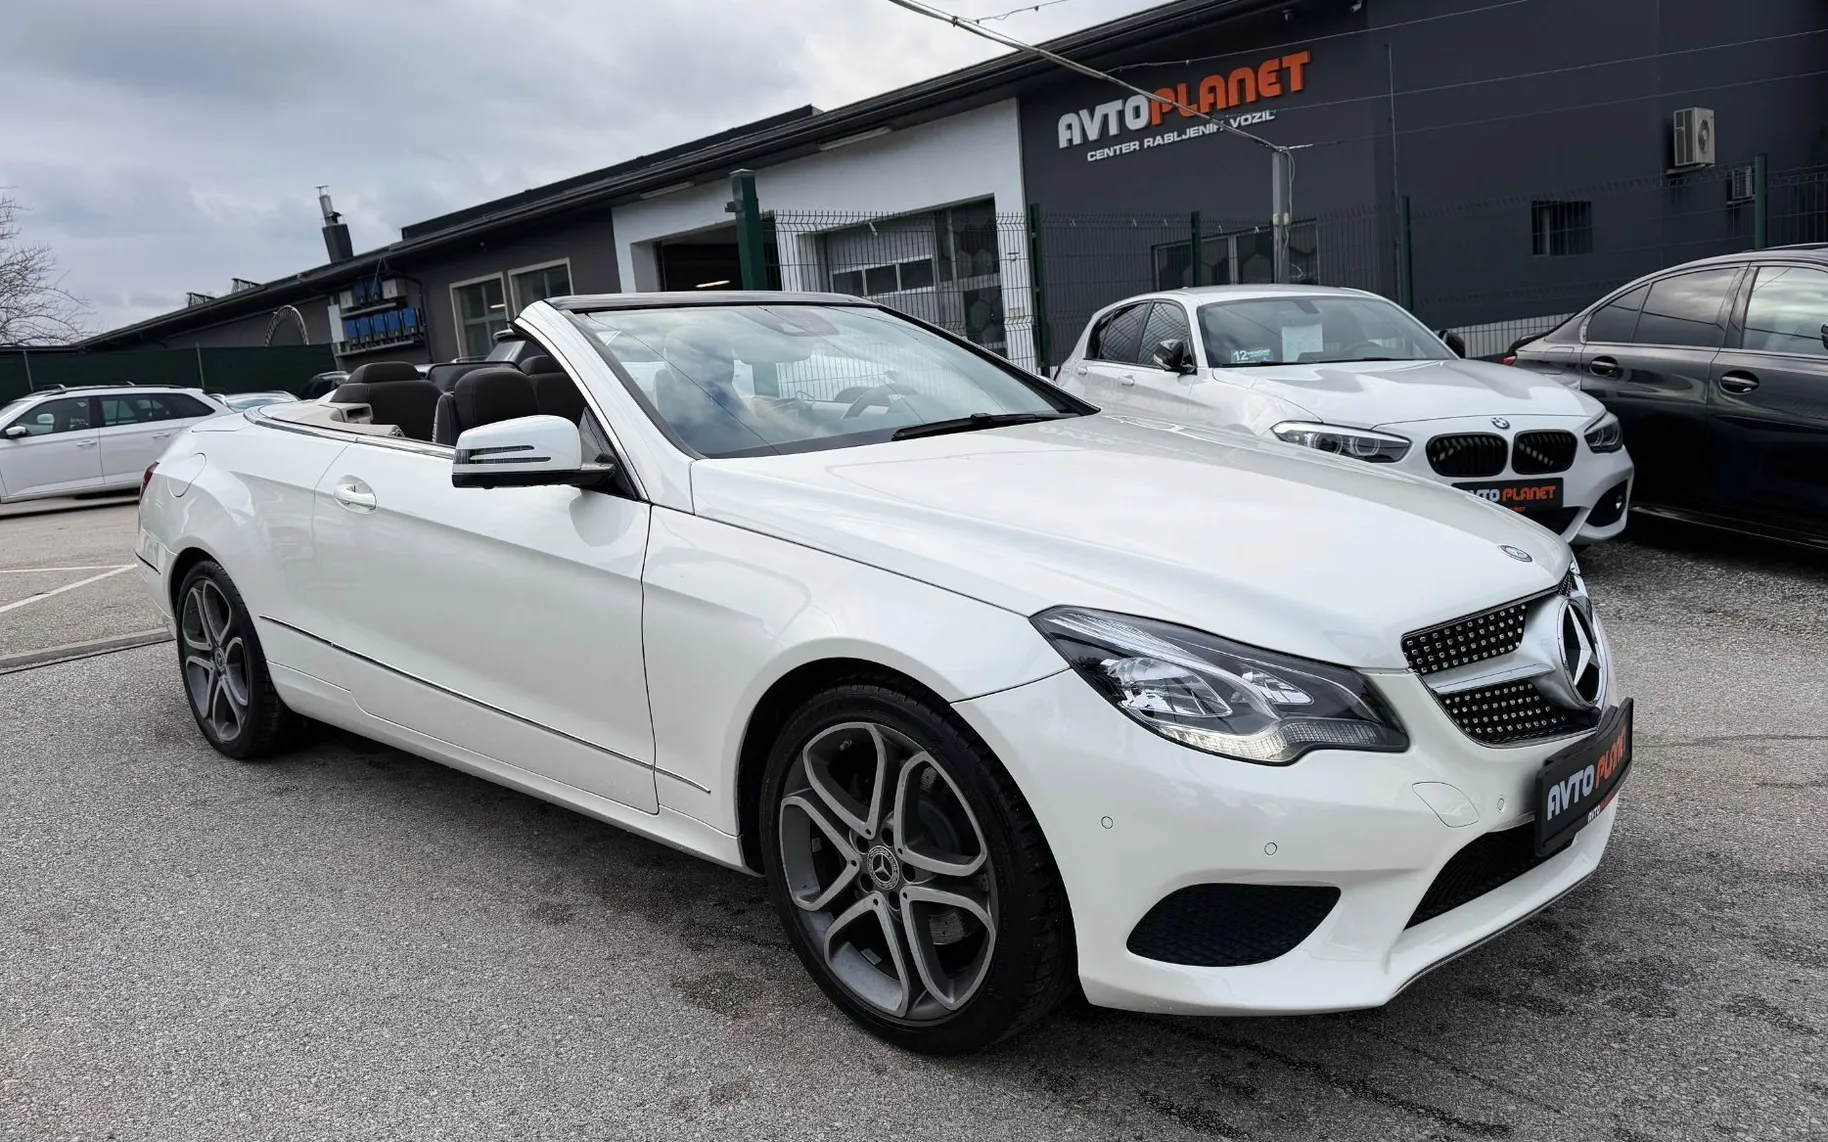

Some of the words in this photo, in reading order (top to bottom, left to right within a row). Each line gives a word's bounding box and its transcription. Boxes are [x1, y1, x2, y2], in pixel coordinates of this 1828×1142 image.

[1058, 51, 1311, 149] AVTOPLANET
[1087, 141, 1140, 162] CENTER
[1229, 109, 1276, 128] VOZIL
[1233, 350, 1249, 361] 12
[1502, 485, 1557, 502] PLANET
[1547, 764, 1595, 821] AVTO
